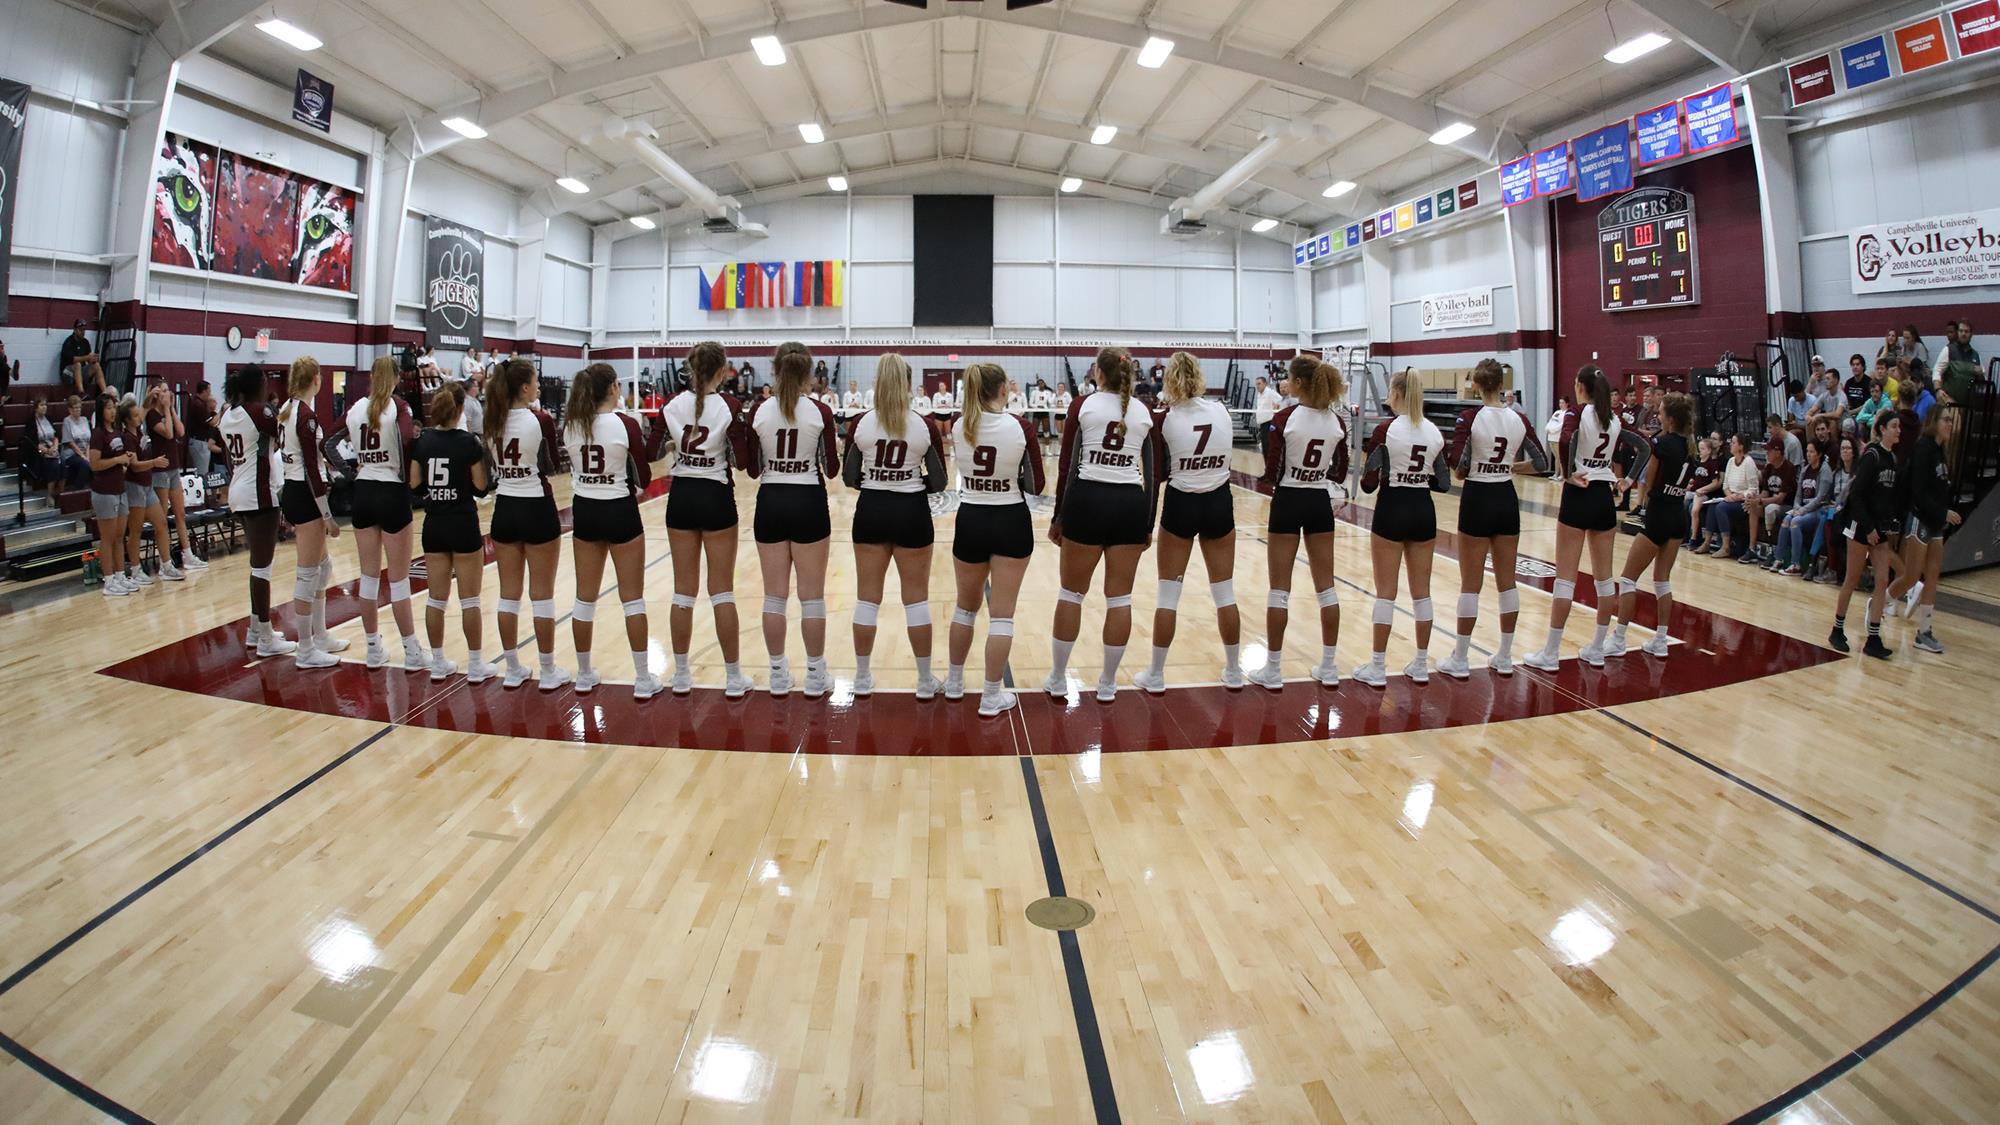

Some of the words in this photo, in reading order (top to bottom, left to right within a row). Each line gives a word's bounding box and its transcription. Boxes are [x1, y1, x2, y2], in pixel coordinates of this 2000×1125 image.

[1616, 198, 1668, 223] TIGERS
[1664, 218, 1686, 230] HOME
[1887, 221, 1938, 236] Campbellsville
[1940, 216, 1978, 229] University
[1602, 231, 1622, 242] GUEST
[1888, 227, 2000, 257] Volleyb
[1627, 256, 1647, 266] PERIOD
[1892, 262, 1909, 271] 2008
[1910, 259, 1938, 269] NCCAA
[1939, 254, 1978, 267] NATIONAL
[1907, 277, 1927, 285] Randy
[1968, 272, 1989, 280] Coach
[431, 279, 479, 314] TIGERS
[1435, 294, 1489, 311] Volleyball
[440, 335, 470, 345] VOLLEYBALL
[360, 423, 380, 450] 16
[681, 424, 710, 456] 12
[776, 428, 799, 460] 11
[1102, 421, 1125, 451] 8
[1193, 423, 1212, 456] 7
[226, 434, 244, 458] 20
[496, 437, 522, 466] 14
[875, 439, 908, 469] 10
[1303, 439, 1325, 468] 6
[1489, 436, 1508, 463] 3
[1593, 433, 1610, 459] 2
[358, 451, 389, 463] TIGERS
[580, 444, 605, 474] 13
[678, 453, 716, 468] TIGERS
[973, 445, 998, 477] 9
[1089, 450, 1134, 467] TIGERS
[1179, 455, 1226, 471] TIGERS
[1408, 444, 1428, 472] 5
[427, 458, 449, 486] 15
[498, 466, 532, 479] TIGERS
[768, 459, 810, 474] TIGERS
[868, 468, 913, 482] TIGERS
[1291, 466, 1326, 482] TIGERS
[1477, 463, 1510, 474] TIGERS
[1676, 462, 1689, 485] 1
[207, 473, 221, 481] LADY
[579, 474, 615, 485] TIGERS
[963, 476, 1011, 493] TIGERS
[427, 488, 458, 501] GERS
